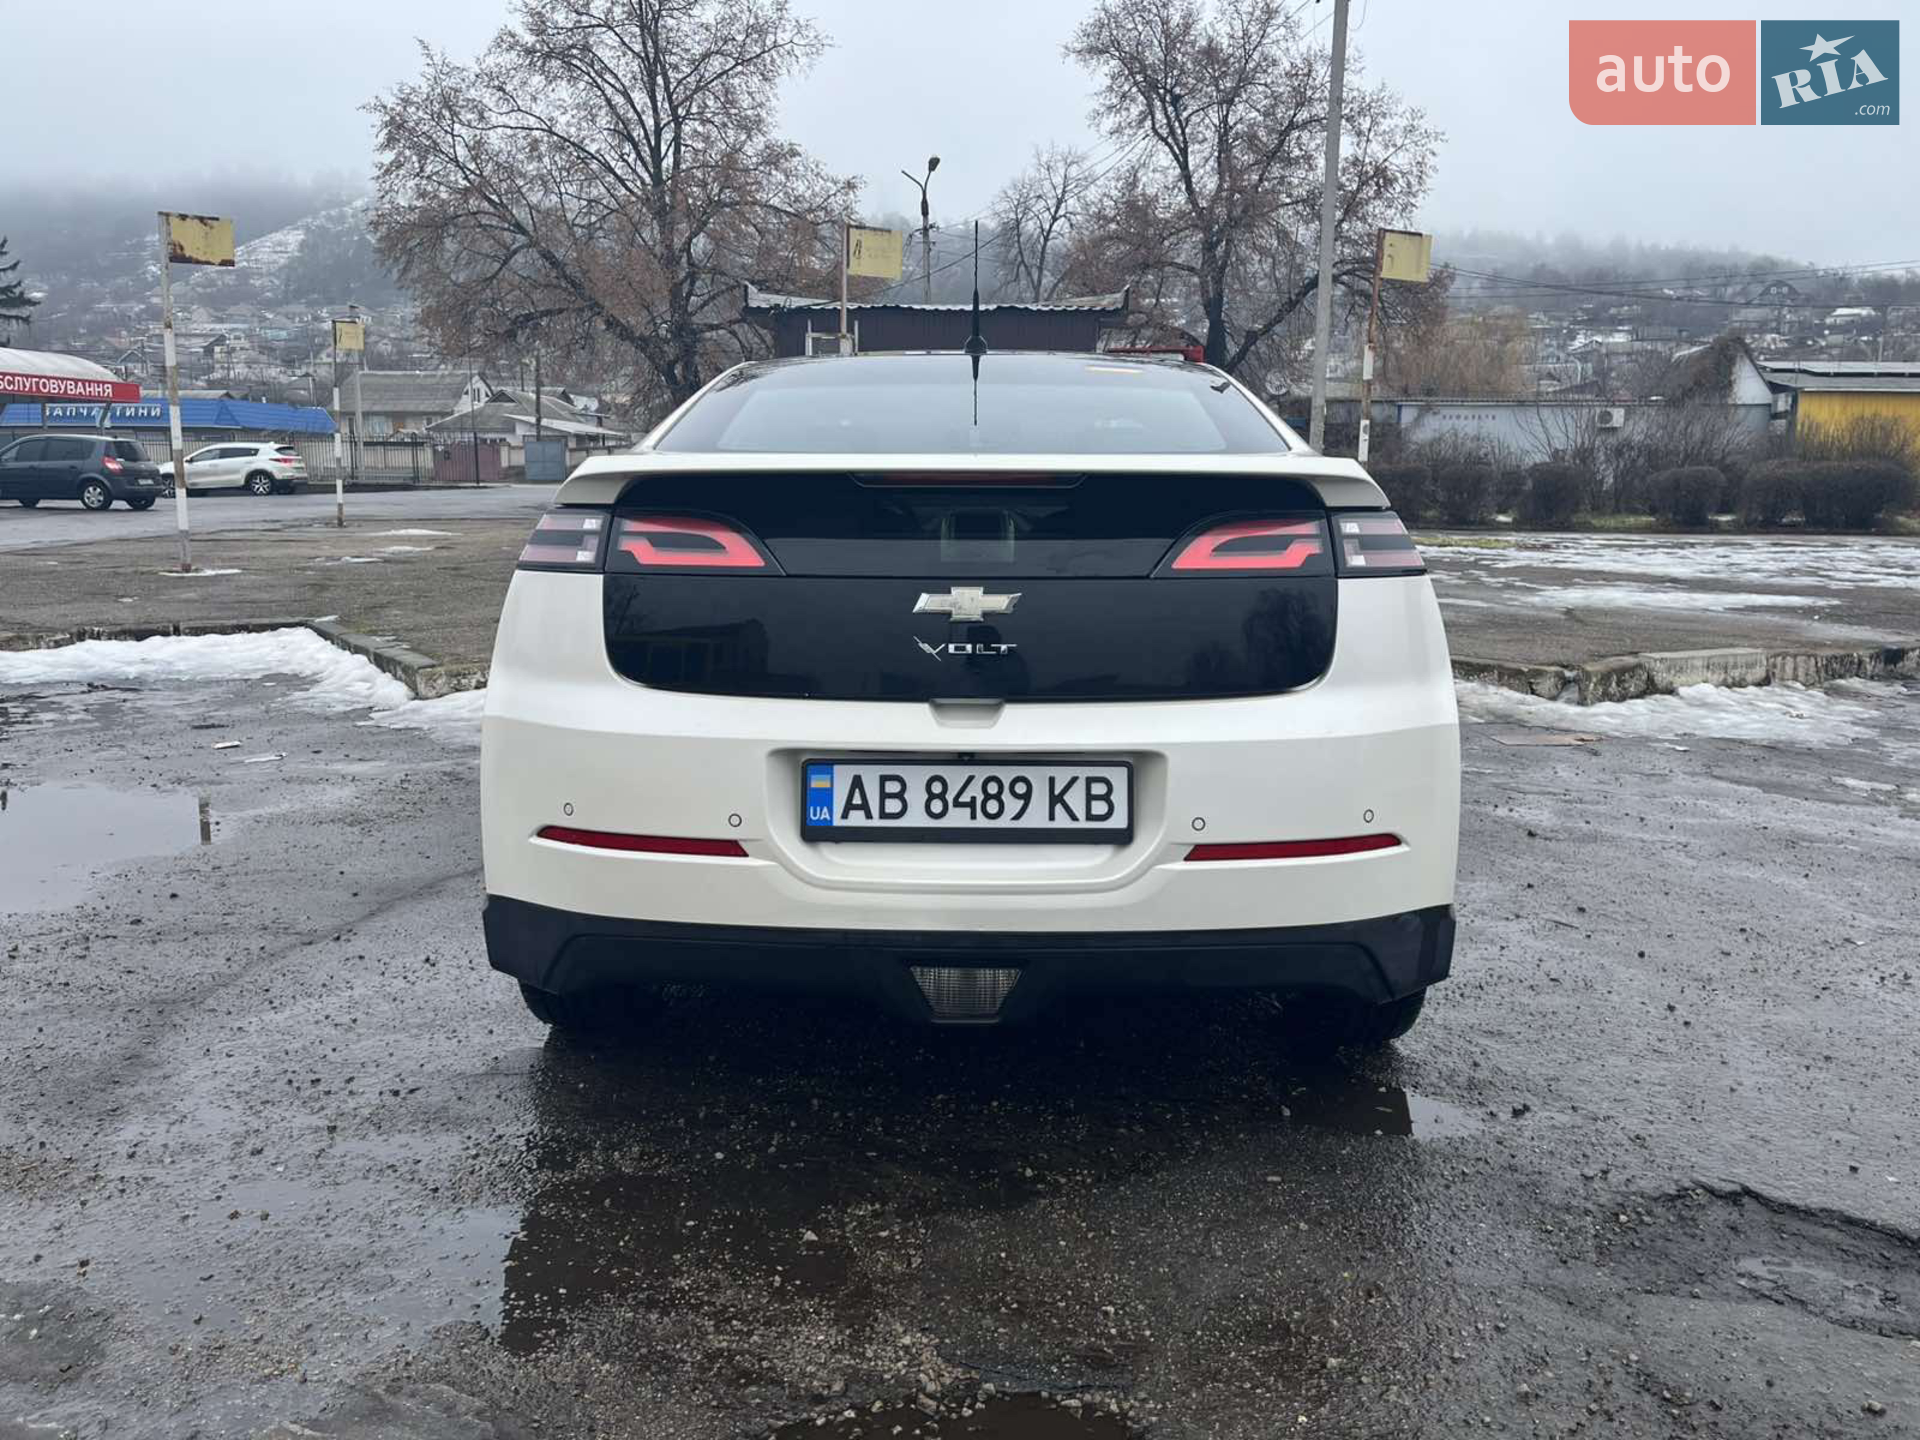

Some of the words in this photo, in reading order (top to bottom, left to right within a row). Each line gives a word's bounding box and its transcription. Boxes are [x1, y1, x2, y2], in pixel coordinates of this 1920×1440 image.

[45, 406, 161, 417] АПЧАТИНИ
[913, 636, 1018, 661] VOLT
[840, 774, 909, 821] AB
[924, 774, 1034, 821] 8489
[1048, 775, 1116, 822] KB
[810, 806, 831, 821] UA
